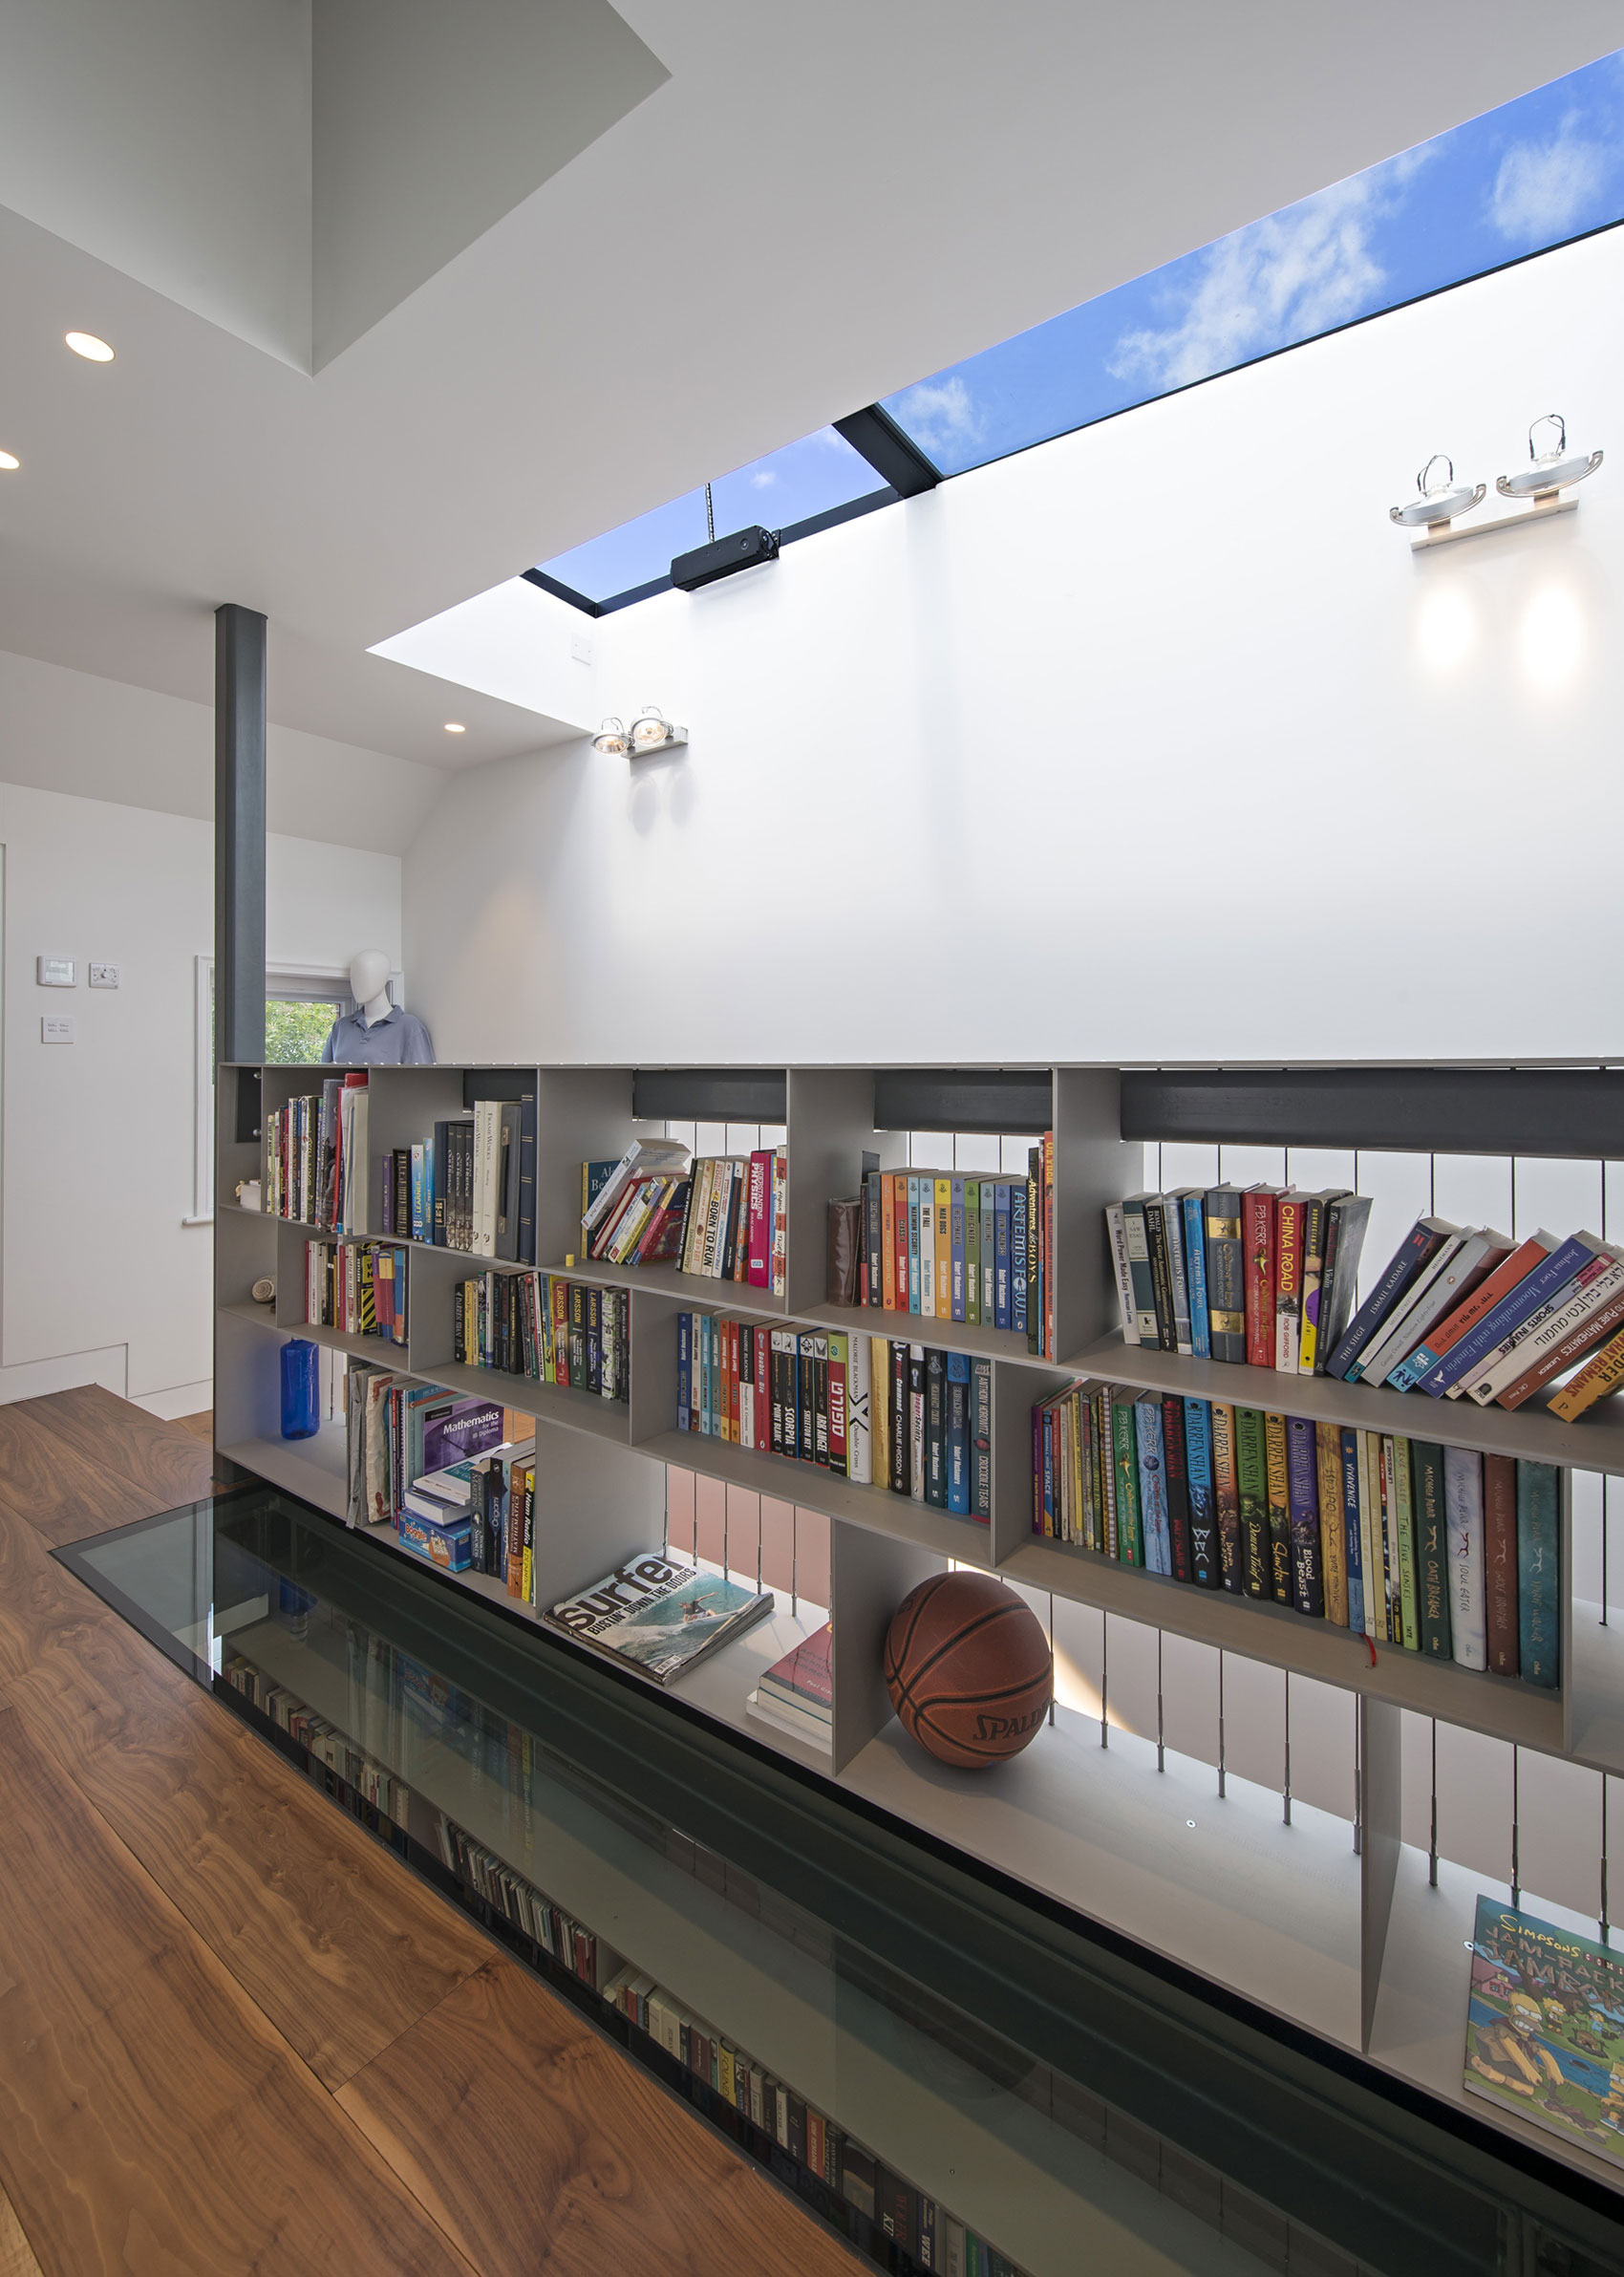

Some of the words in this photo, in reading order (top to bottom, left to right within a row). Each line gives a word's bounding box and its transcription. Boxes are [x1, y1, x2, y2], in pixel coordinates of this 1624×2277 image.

[751, 1162, 759, 1210] PHYSICS
[709, 1201, 719, 1227] BORN
[1029, 1180, 1037, 1230] Adventures
[1331, 1212, 1339, 1223] The
[707, 1229, 716, 1242] TO
[1014, 1192, 1027, 1265] ARTEMIS
[1154, 1210, 1163, 1233] ROALD
[1281, 1205, 1294, 1249] CHINA
[704, 1245, 715, 1267] RUN
[715, 1221, 725, 1270] FREAKONOMICS
[1173, 1236, 1183, 1274] ARTEMIS
[1431, 1244, 1454, 1270] HEINEMANN
[1552, 1247, 1579, 1272] Joshua
[1118, 1245, 1126, 1262] Power
[1122, 1278, 1130, 1292] Easy
[1194, 1249, 1203, 1283] ARTEMIS
[1281, 1253, 1294, 1292] ROAD
[1324, 1269, 1335, 1289] Violin
[1537, 1268, 1557, 1287] Foer
[1014, 1269, 1027, 1318] FOWL
[1196, 1287, 1205, 1309] FOWL
[1485, 1282, 1543, 1334] Moonwalking
[1339, 1345, 1351, 1362] THE
[1350, 1325, 1366, 1348] SIEGE
[1369, 1292, 1389, 1315] ISMAIL
[1386, 1260, 1408, 1293] KADARE
[1526, 1302, 1555, 1329] SPORTS
[1597, 1306, 1618, 1327] PURE
[1471, 1328, 1494, 1350] with
[1497, 1325, 1530, 1356] INJURIES
[1533, 1316, 1570, 1349] מחמודי
[1559, 1320, 1603, 1359] MATHEMATICS
[1442, 1343, 1477, 1375] Einstein
[978, 1376, 989, 1404] ANTHONY
[1562, 1356, 1611, 1400] REMAINS
[443, 1410, 500, 1435] Mathematics
[482, 1421, 491, 1429] for
[491, 1419, 500, 1428] the
[774, 1403, 782, 1422] POINT
[817, 1412, 827, 1429] ARK
[831, 1381, 844, 1438] ספורט
[978, 1406, 990, 1434] HOROWITZ
[479, 1426, 500, 1439] Diploma
[774, 1423, 782, 1443] BLANC
[785, 1407, 795, 1445] SCORPIA
[817, 1429, 828, 1451] ANGEL
[1119, 1426, 1130, 1450] KERR
[1144, 1425, 1158, 1456] KERR
[1187, 1412, 1204, 1457] DARREN
[1213, 1419, 1229, 1460] DARREN
[1240, 1421, 1256, 1464] DARREN
[1268, 1425, 1283, 1467] DARREN
[1292, 1433, 1309, 1475] DARREN
[979, 1455, 990, 1487] CROCODILE
[1190, 1459, 1207, 1485] SHAN
[1216, 1461, 1230, 1491] SHAN
[1242, 1463, 1259, 1493] SHAN
[1269, 1468, 1285, 1498] SHAN
[1346, 1462, 1357, 1508] VIVAVENICE
[1424, 1465, 1434, 1497] MICHELLE
[1457, 1471, 1466, 1502] MICHELLE
[979, 1488, 990, 1508] TEARS
[1294, 1476, 1311, 1507] SHAN
[1425, 1497, 1436, 1518] PAVER
[1458, 1504, 1468, 1524] PAVER
[405, 1522, 427, 1542] Boggle
[1249, 1521, 1260, 1556] Demon
[1400, 1516, 1409, 1536] THE
[1227, 1541, 1235, 1567] Demon
[1271, 1540, 1289, 1582] Slawter
[1303, 1548, 1314, 1579] Blood
[1296, 1560, 1308, 1598] Beast
[1402, 1568, 1411, 1599] SENSES
[1426, 1559, 1440, 1582] OATH
[1459, 1563, 1470, 1584] SOUL
[1496, 1570, 1506, 1591] WOLF
[623, 1596, 655, 1615] DOWN
[650, 1585, 671, 1603] THE
[665, 1567, 697, 1591] DOORS
[1427, 1583, 1441, 1620] BREAKER
[1460, 1587, 1470, 1612] EATER
[1531, 1579, 1543, 1606] SPIRIT
[1496, 1595, 1507, 1629] BROTHER
[1530, 1608, 1543, 1642] WALKER
[972, 1698, 1049, 1740] SPALD
[1499, 1914, 1581, 1958] SIMPSONS
[1485, 1926, 1624, 1991] JAM-PACK
[1483, 1940, 1624, 2016] JAMBOR
